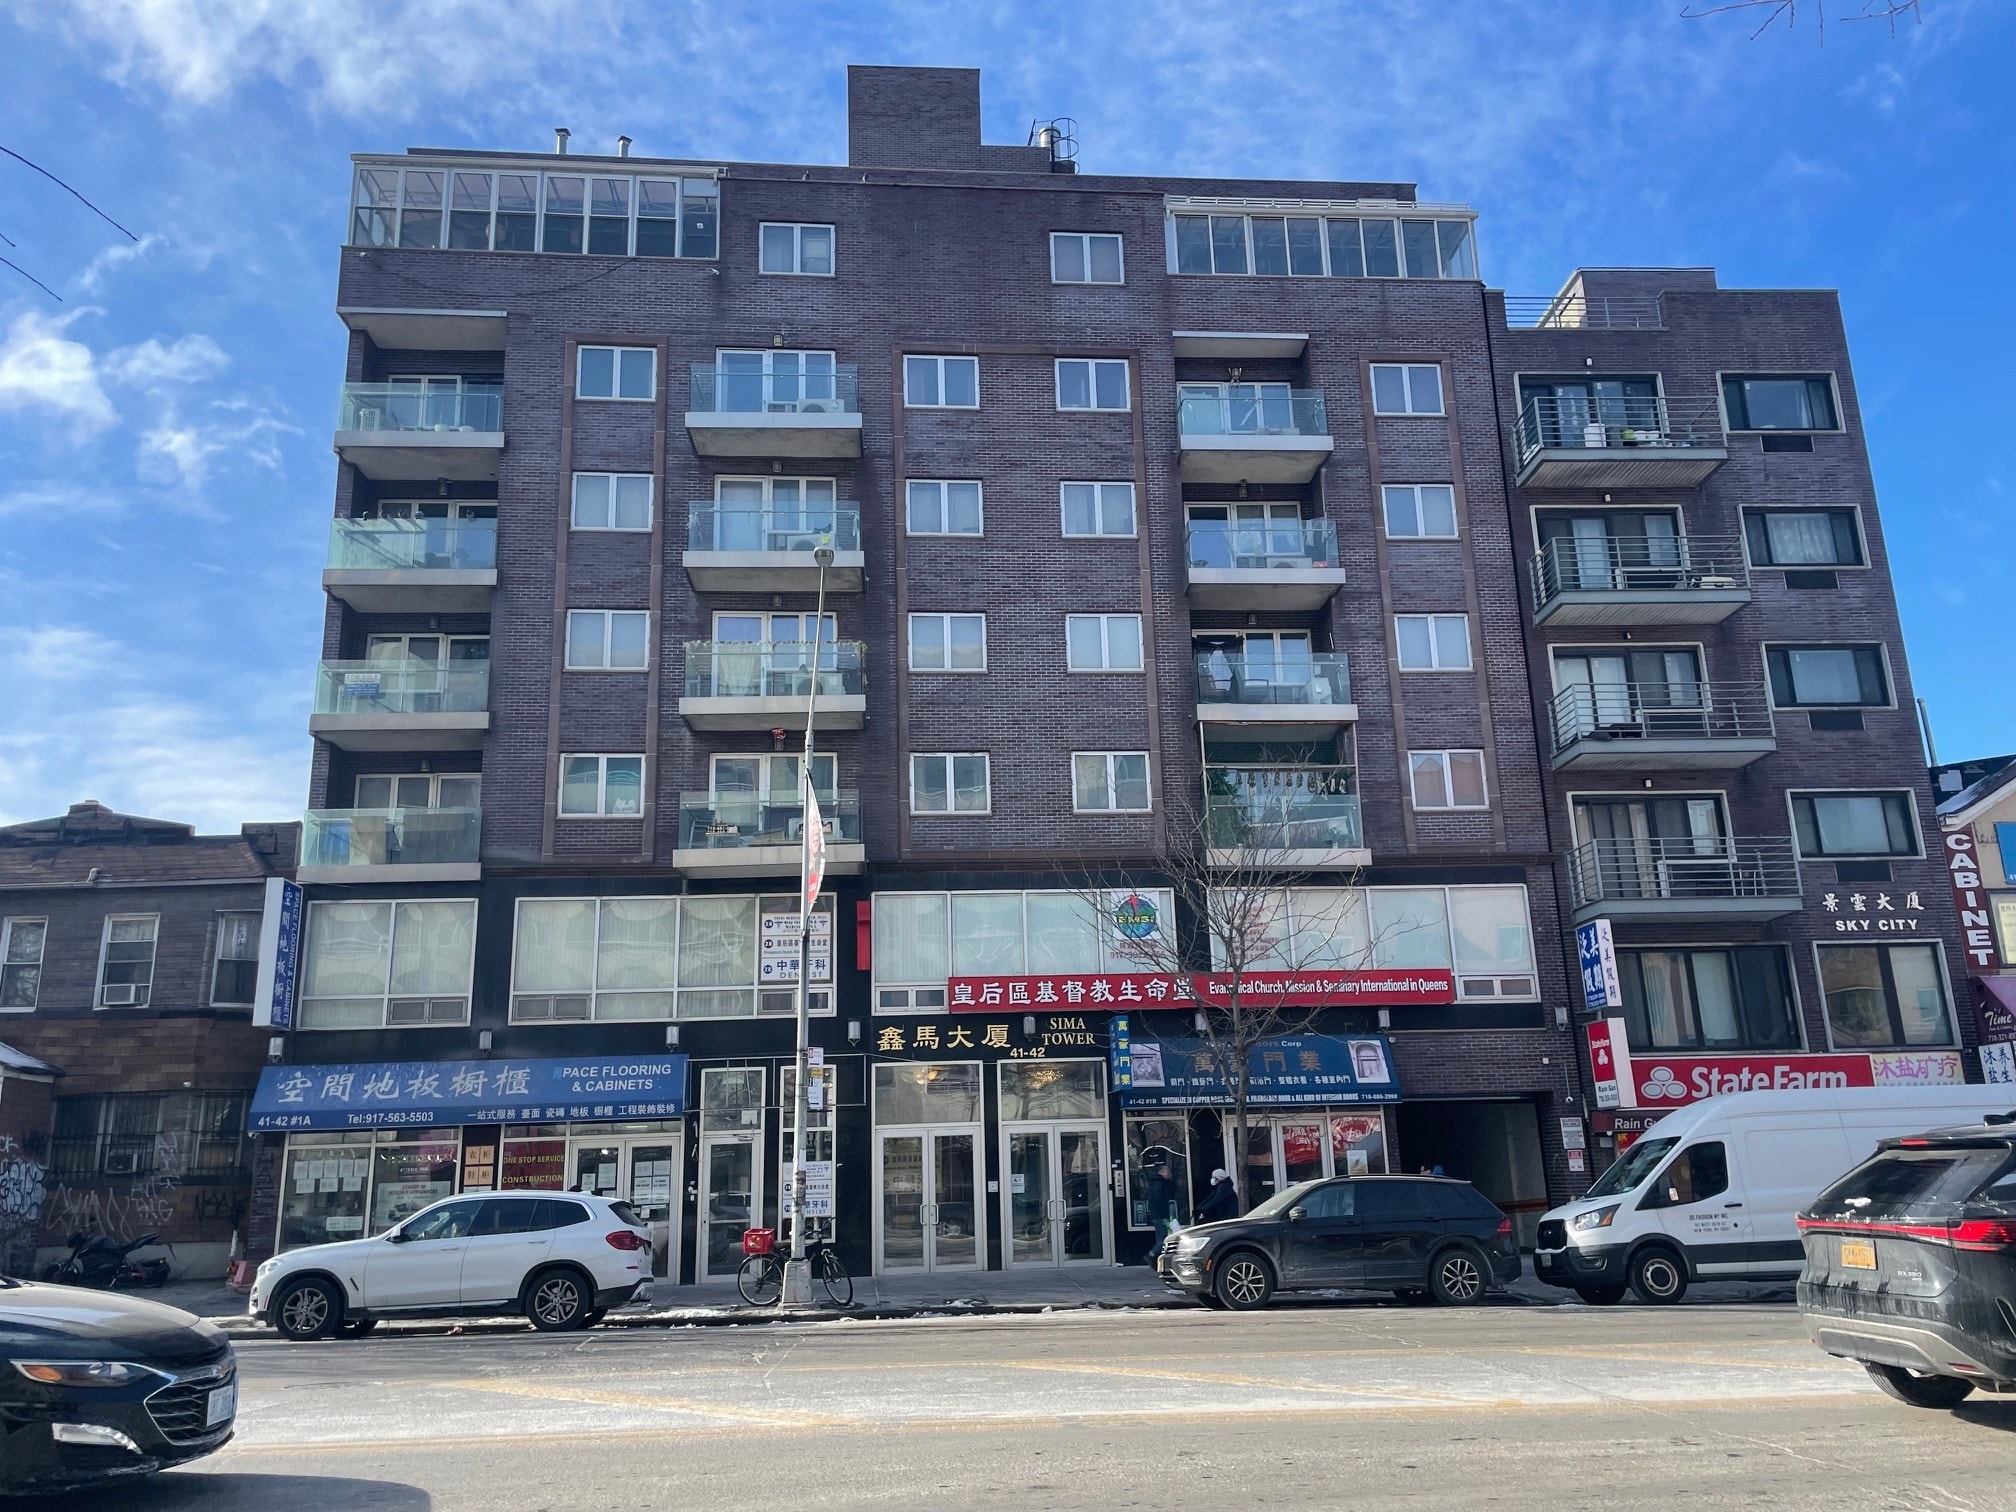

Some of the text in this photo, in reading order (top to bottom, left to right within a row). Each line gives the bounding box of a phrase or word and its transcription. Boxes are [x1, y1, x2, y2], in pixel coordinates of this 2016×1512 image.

[292, 891, 301, 920] SPACE
[1946, 834, 1994, 966] CABINET
[1835, 919, 1918, 931] SKY CITY
[288, 922, 299, 968] FLOORING
[1316, 980, 1323, 992] &
[1360, 978, 1409, 992] International
[1409, 978, 1418, 991] in
[1418, 978, 1448, 993] Queens
[1050, 1017, 1086, 1030] SIMA
[1985, 1007, 2013, 1027] Time
[1041, 1032, 1096, 1046] TOWER
[1010, 1047, 1046, 1058] 41-42
[602, 1064, 672, 1076] FLOORING
[572, 1079, 654, 1092] & CABINETS
[570, 1106, 589, 1117] 地板
[258, 1111, 434, 1126] 41-42 #1A Tel:917-563-5503
[1614, 1117, 1641, 1130] Rain
[503, 1154, 565, 1164] ONE STOP SERVICE
[502, 1174, 564, 1184] CONSTRUCTION
